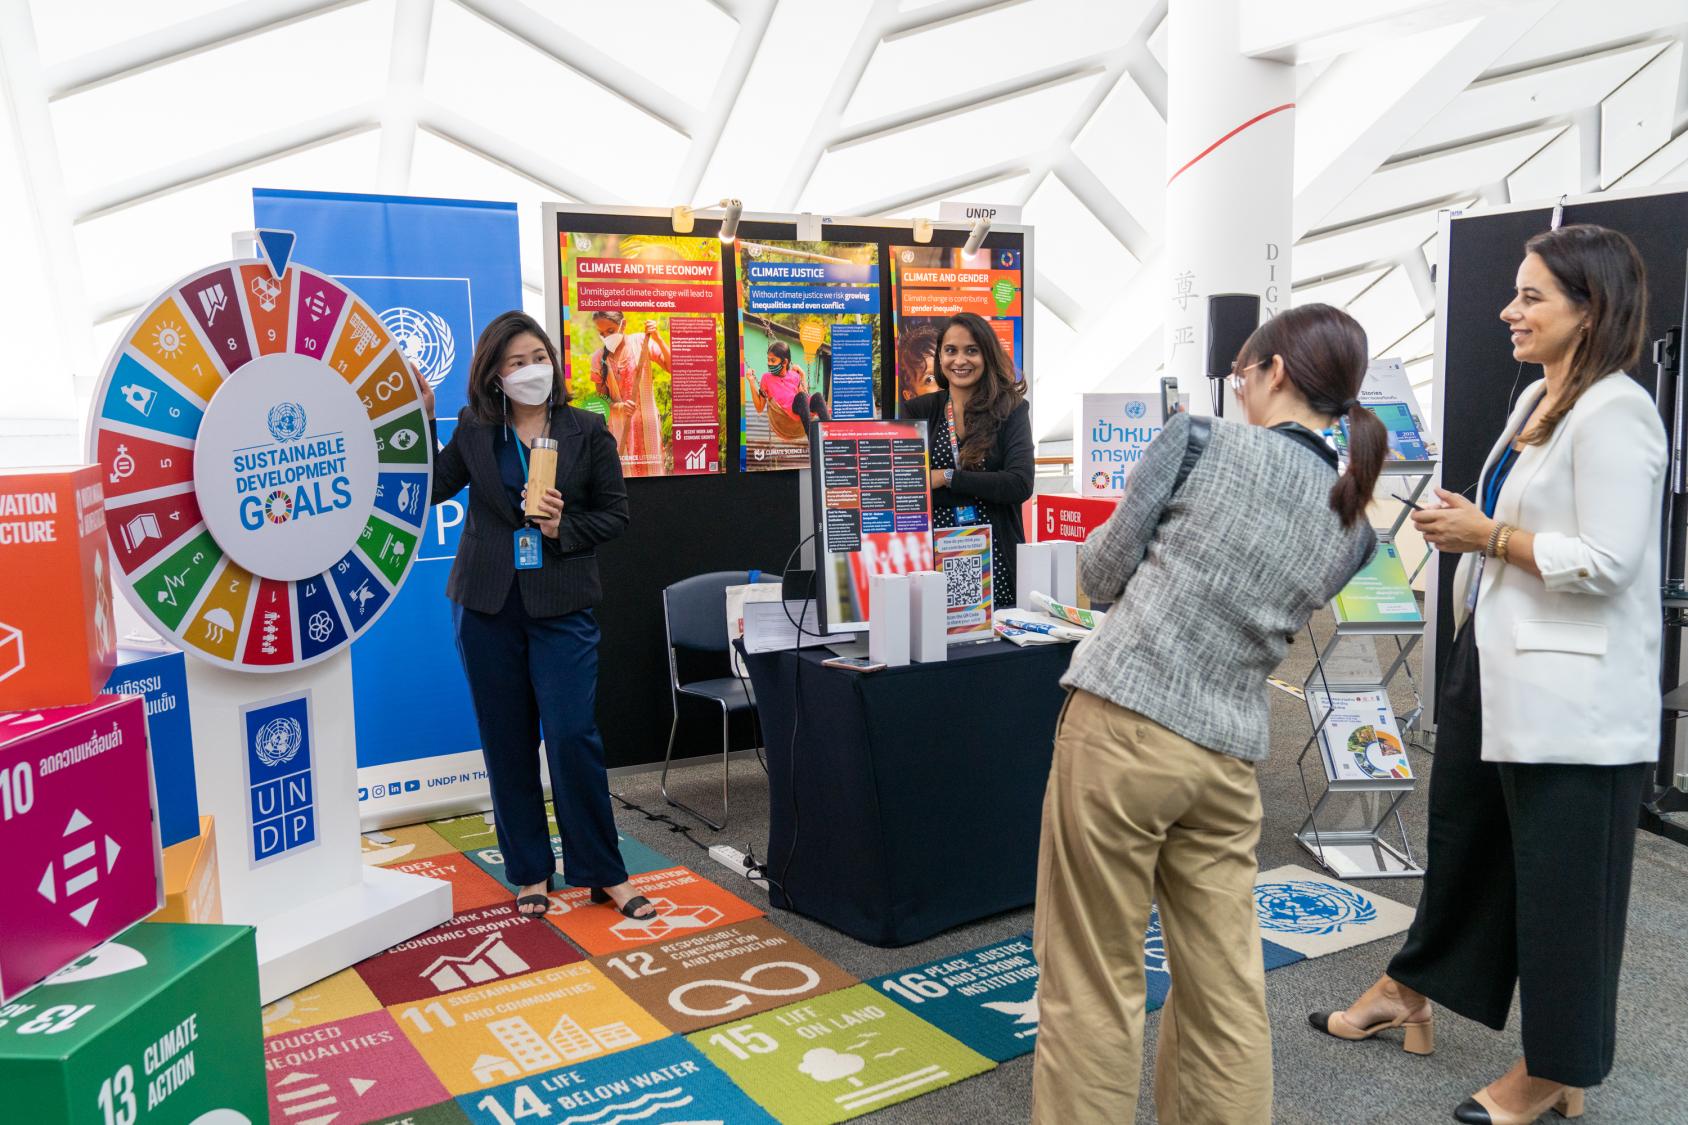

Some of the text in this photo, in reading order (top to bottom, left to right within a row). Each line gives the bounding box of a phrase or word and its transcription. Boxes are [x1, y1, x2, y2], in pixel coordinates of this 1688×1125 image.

[966, 208, 997, 219] UNDP
[579, 262, 713, 276] CLIMATE AND THE ECONOMY
[751, 267, 824, 278] CLIMATE JUSTICE
[903, 272, 989, 283] CLIMATE AND GENDER
[580, 287, 625, 298] Unmitigated
[626, 288, 652, 297] climate
[652, 289, 677, 298] change
[677, 289, 690, 298] will
[690, 290, 704, 298] lead
[752, 290, 778, 299] Without
[779, 291, 801, 299] climate
[802, 291, 824, 300] justice
[844, 293, 870, 301] growing
[903, 294, 927, 302] Climate
[927, 295, 949, 304] change
[953, 296, 988, 304] contributing
[580, 299, 676, 308] substantial economic costs.
[752, 301, 791, 310] inequalities
[267, 329, 277, 342] 9
[227, 338, 238, 350] 8
[304, 336, 317, 351] 10
[192, 364, 204, 377] 7
[337, 360, 348, 374] 11
[362, 396, 373, 410] 12
[169, 407, 181, 418] 6
[676, 430, 682, 440] 8
[233, 438, 346, 473] SUSTAINABLE
[161, 458, 172, 469] 5
[236, 457, 347, 494] DEVELOPMENT
[377, 484, 385, 498] 14
[239, 475, 353, 531] GOALS
[169, 511, 181, 522] 4
[436, 502, 465, 545] P
[1046, 507, 1082, 533] 5 GENDER
[0, 520, 57, 545] CTURE
[362, 525, 373, 540] 15
[1060, 524, 1086, 538] EQUALITY
[192, 552, 204, 565] 3
[338, 560, 351, 575] 16
[228, 580, 240, 593] 2
[305, 583, 317, 598] 17
[271, 591, 277, 603] 1
[39, 722, 123, 777] ลดความเหลื่อมล้ำ
[427, 775, 457, 788] UNDP
[460, 773, 470, 783] IN
[0, 761, 34, 822] 10
[477, 850, 504, 865] 6
[397, 861, 437, 873] DER
[483, 906, 513, 919] AND
[546, 897, 572, 915] 9
[388, 916, 531, 955] ECONOMIC GROWTH
[607, 927, 741, 980] 12 RESPONSIBLE
[670, 934, 759, 962] CONSUMPTION
[682, 936, 787, 970] AND PRODUCTION
[882, 941, 1033, 1003] 16 PEACE, JUSTICE
[944, 955, 1032, 988] AND STRONG
[401, 964, 593, 1034] 11 SUSTAINABLE CITIES
[463, 983, 597, 1023] AND COMMUNITIES
[796, 1005, 887, 1040] ON LAND
[709, 1005, 818, 1061] 15 LIFE
[143, 1013, 199, 1076] CLIMATE
[98, 1050, 195, 1125] 13 ACTION
[557, 1060, 701, 1110] BELOW WATER
[477, 1070, 586, 1125] 14 LIFE
